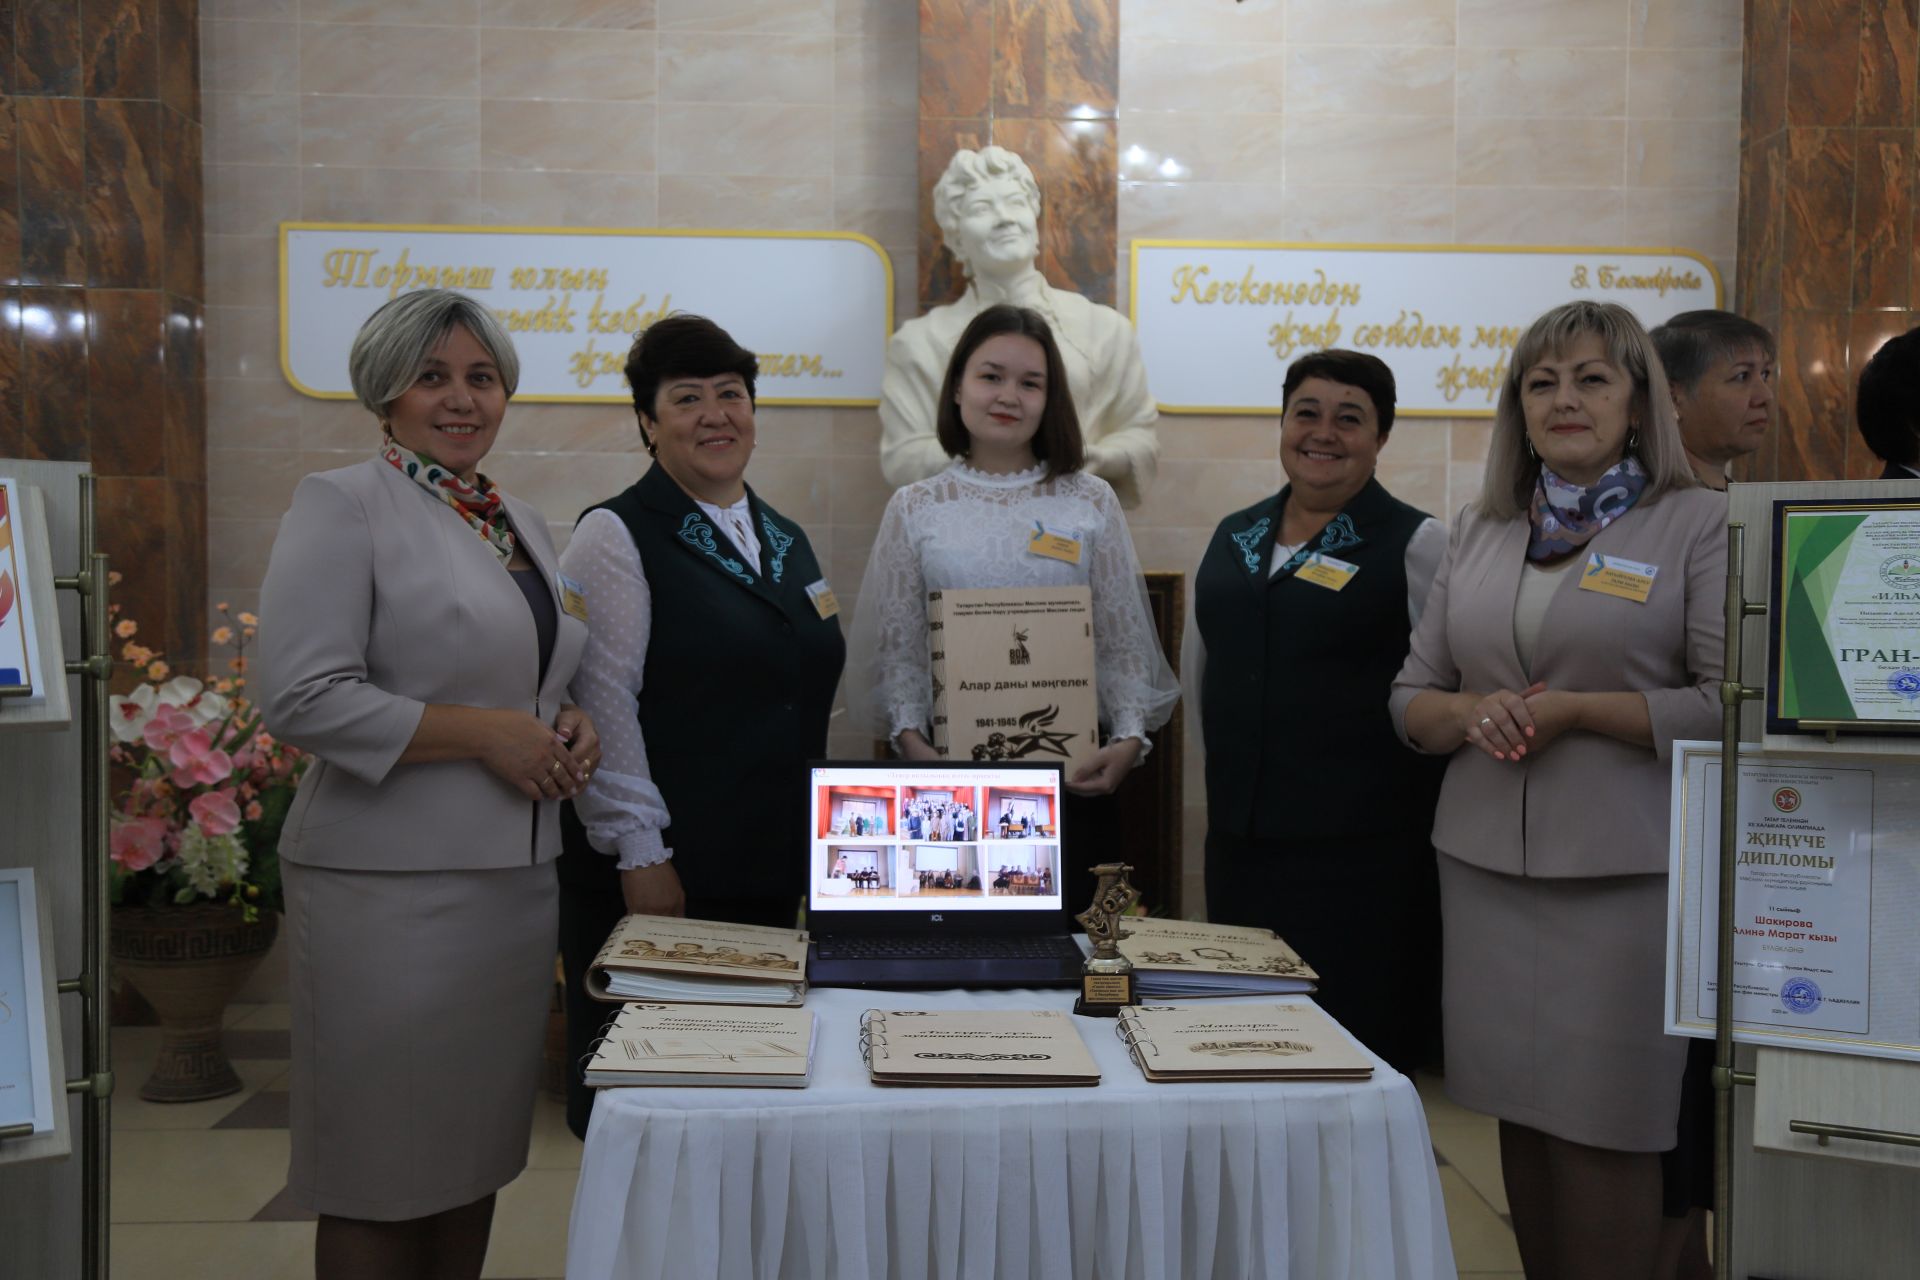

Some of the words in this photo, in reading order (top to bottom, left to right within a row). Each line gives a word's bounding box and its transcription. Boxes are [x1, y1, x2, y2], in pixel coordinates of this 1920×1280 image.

[321, 246, 497, 300] Тормыш
[509, 265, 610, 292] юлын
[959, 680, 992, 692] Алар
[994, 680, 1028, 691] даны
[1031, 678, 1089, 690] мәңгелек
[975, 717, 1018, 728] 1941-1945
[1746, 832, 1826, 849] ҖИҢҮЧЕ
[1737, 851, 1835, 870] ДИПЛОМЫ
[931, 914, 944, 922] ICL
[1755, 915, 1813, 928] Шакирова
[1733, 926, 1765, 937] Алинә
[1767, 929, 1807, 941] Марат
[1808, 934, 1838, 942] кызы
